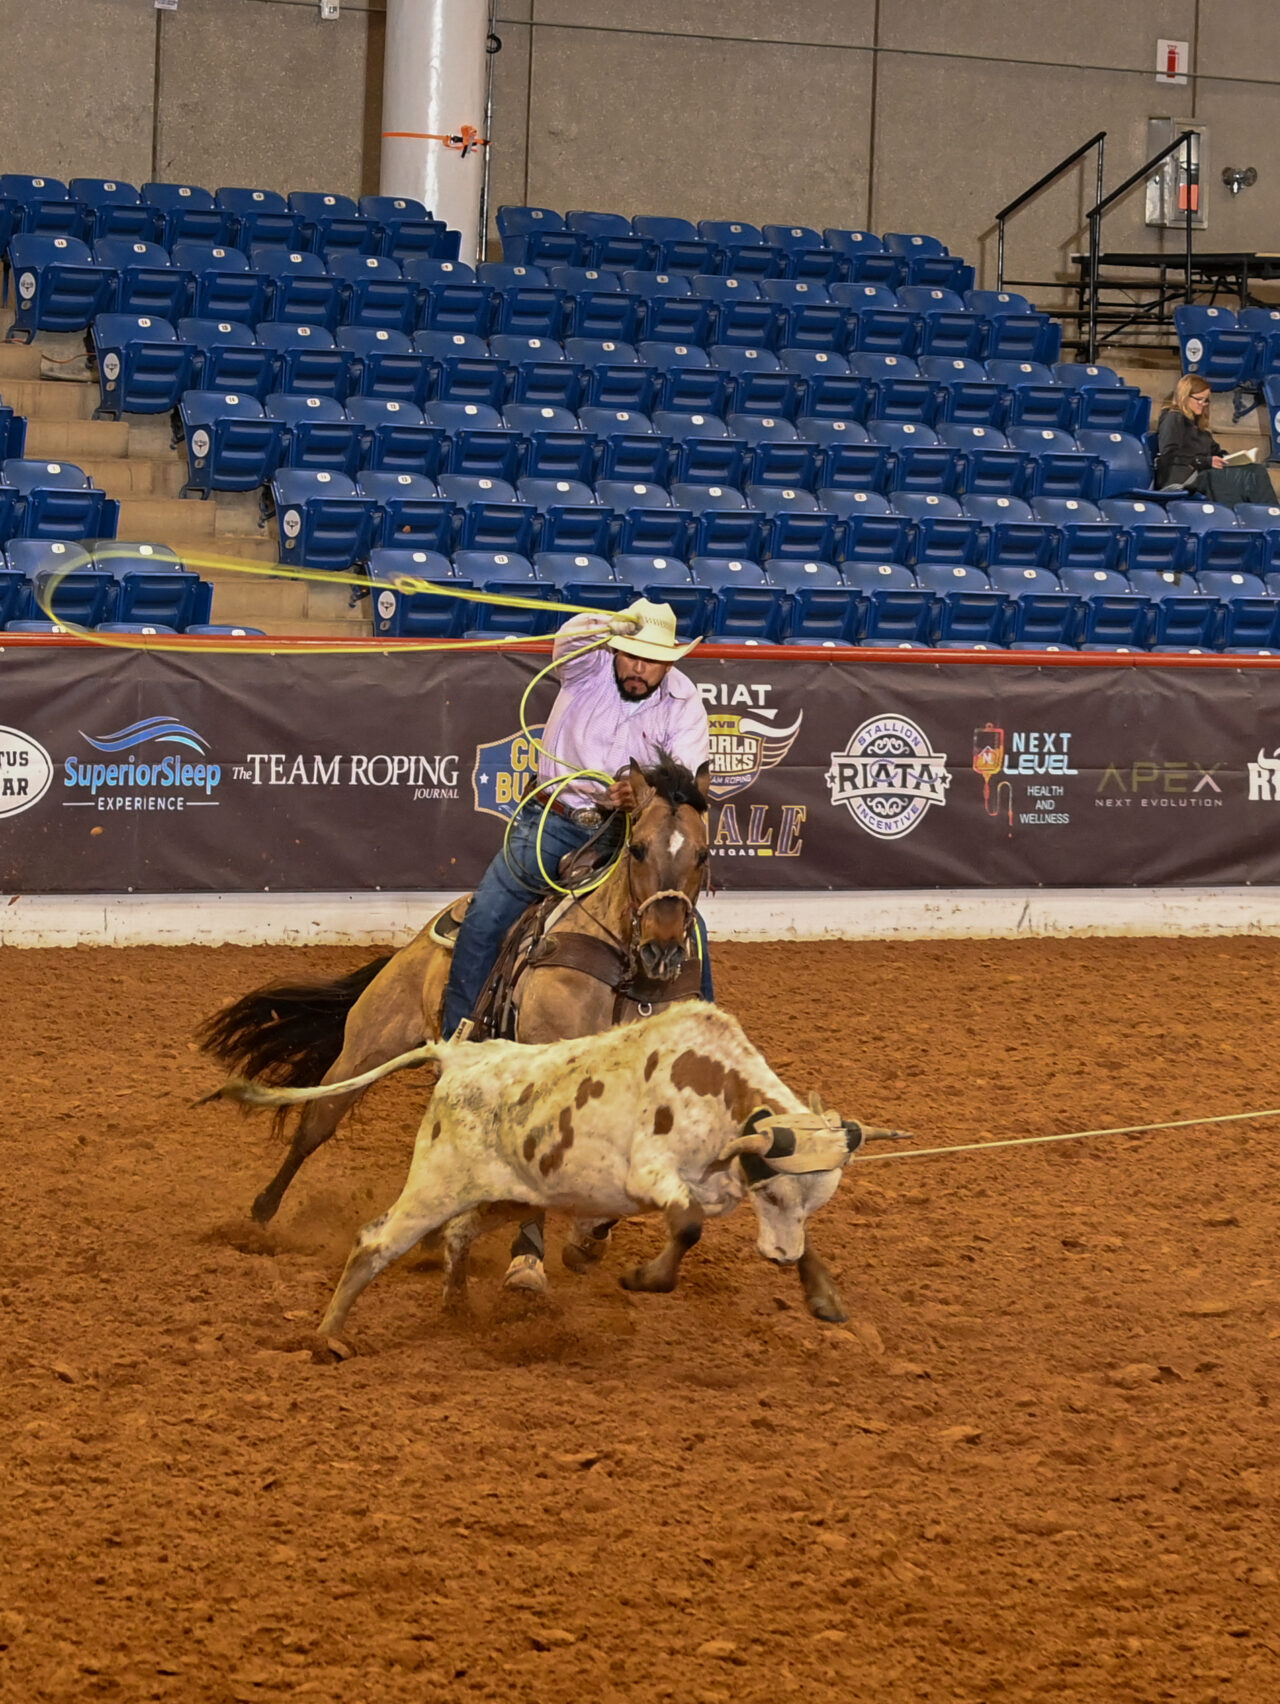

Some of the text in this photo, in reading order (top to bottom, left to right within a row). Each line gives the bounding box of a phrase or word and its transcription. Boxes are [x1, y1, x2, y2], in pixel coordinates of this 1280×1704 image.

[857, 722, 921, 747] STALLION
[1012, 732, 1072, 752] NEXT
[232, 754, 459, 786] The TEAM ROPING
[1003, 754, 1079, 775] LEVEL
[838, 763, 939, 794] RIATA
[1097, 761, 1222, 792] APEX
[413, 788, 459, 801] JOURNAL
[1027, 785, 1064, 796] HEALTH
[97, 797, 184, 811] EXPERIENCE
[1035, 799, 1056, 810] AND
[1095, 799, 1223, 807] NEXT EVOLUTION
[856, 803, 920, 831] INCENTIVE
[1019, 813, 1070, 824] WELLNESS
[710, 848, 756, 857] VEGAS
